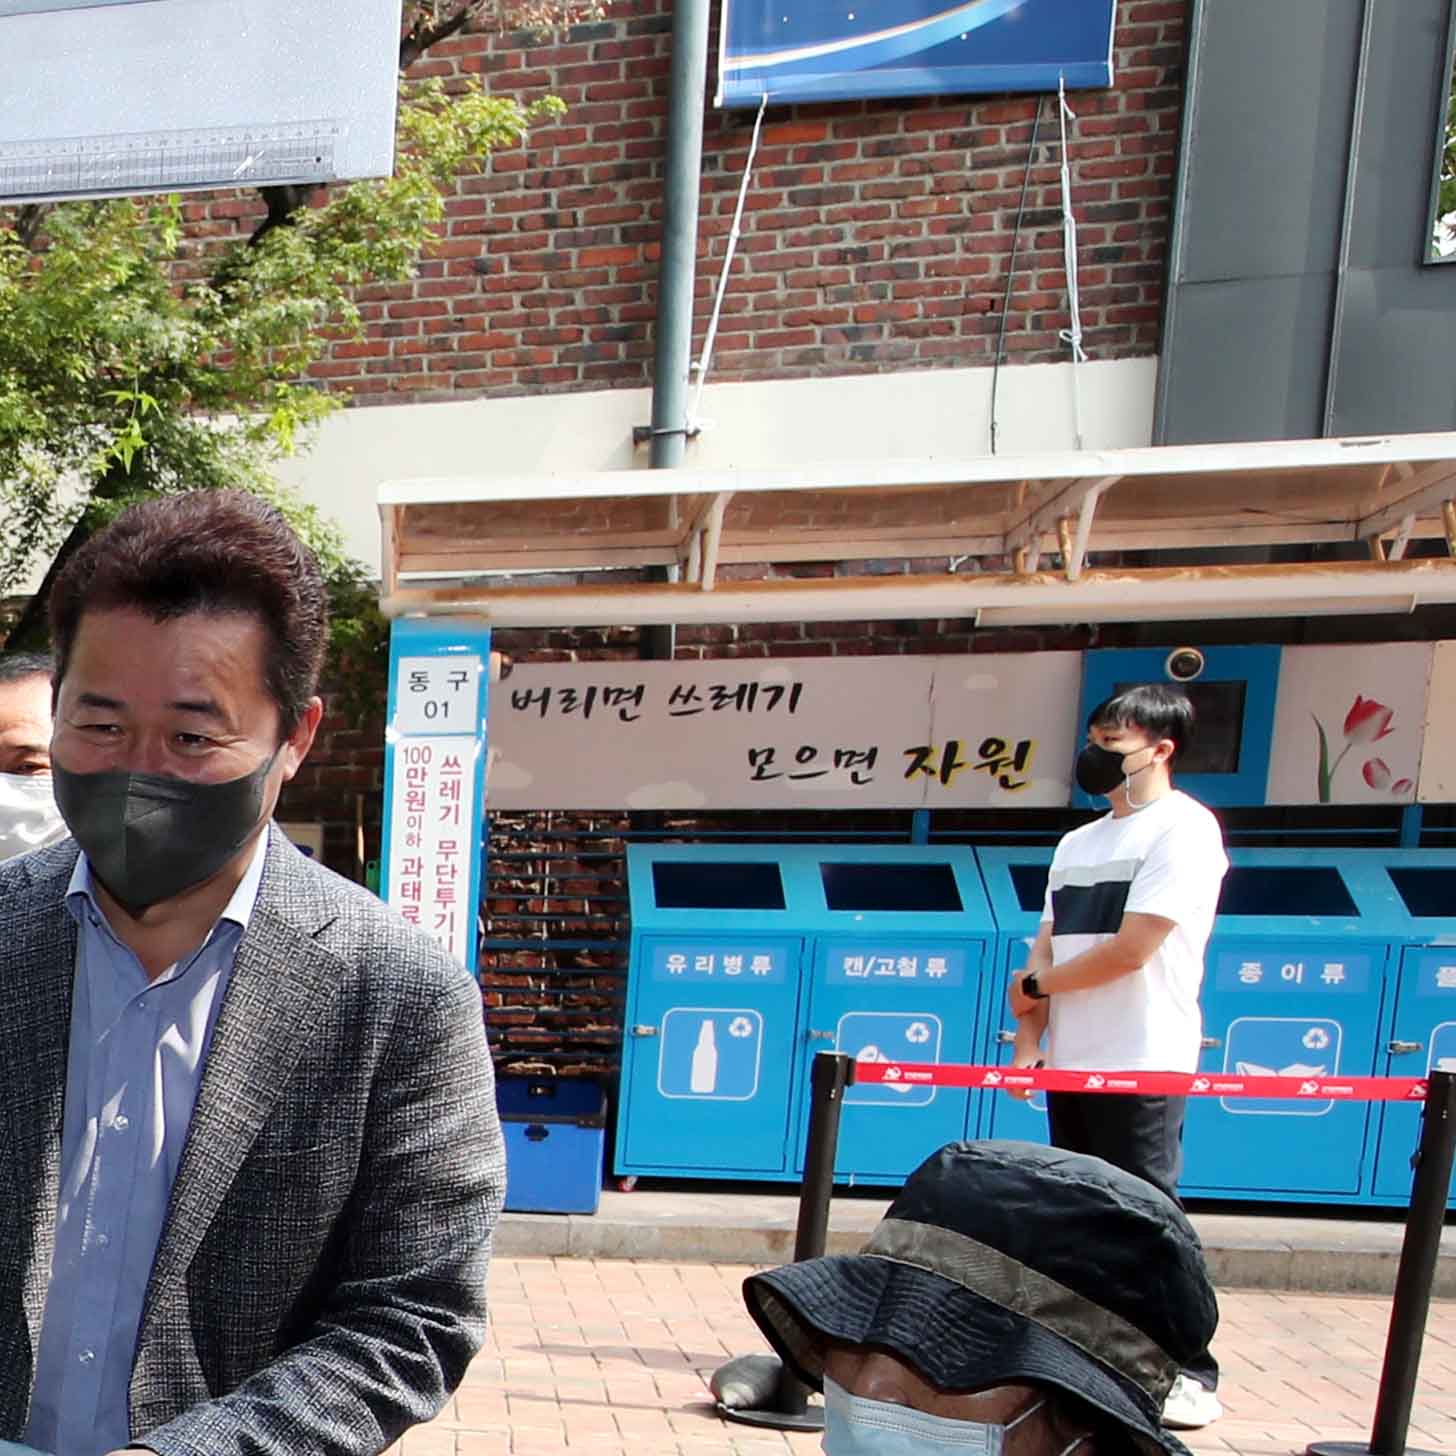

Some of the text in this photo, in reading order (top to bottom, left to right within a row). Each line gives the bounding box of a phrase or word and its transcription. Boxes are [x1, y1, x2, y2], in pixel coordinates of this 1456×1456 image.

[424, 700, 449, 719] 01
[510, 682, 803, 723] 버리면 쓰레기
[747, 737, 1035, 791] 모으면 자원
[438, 754, 463, 825] 쓰레기
